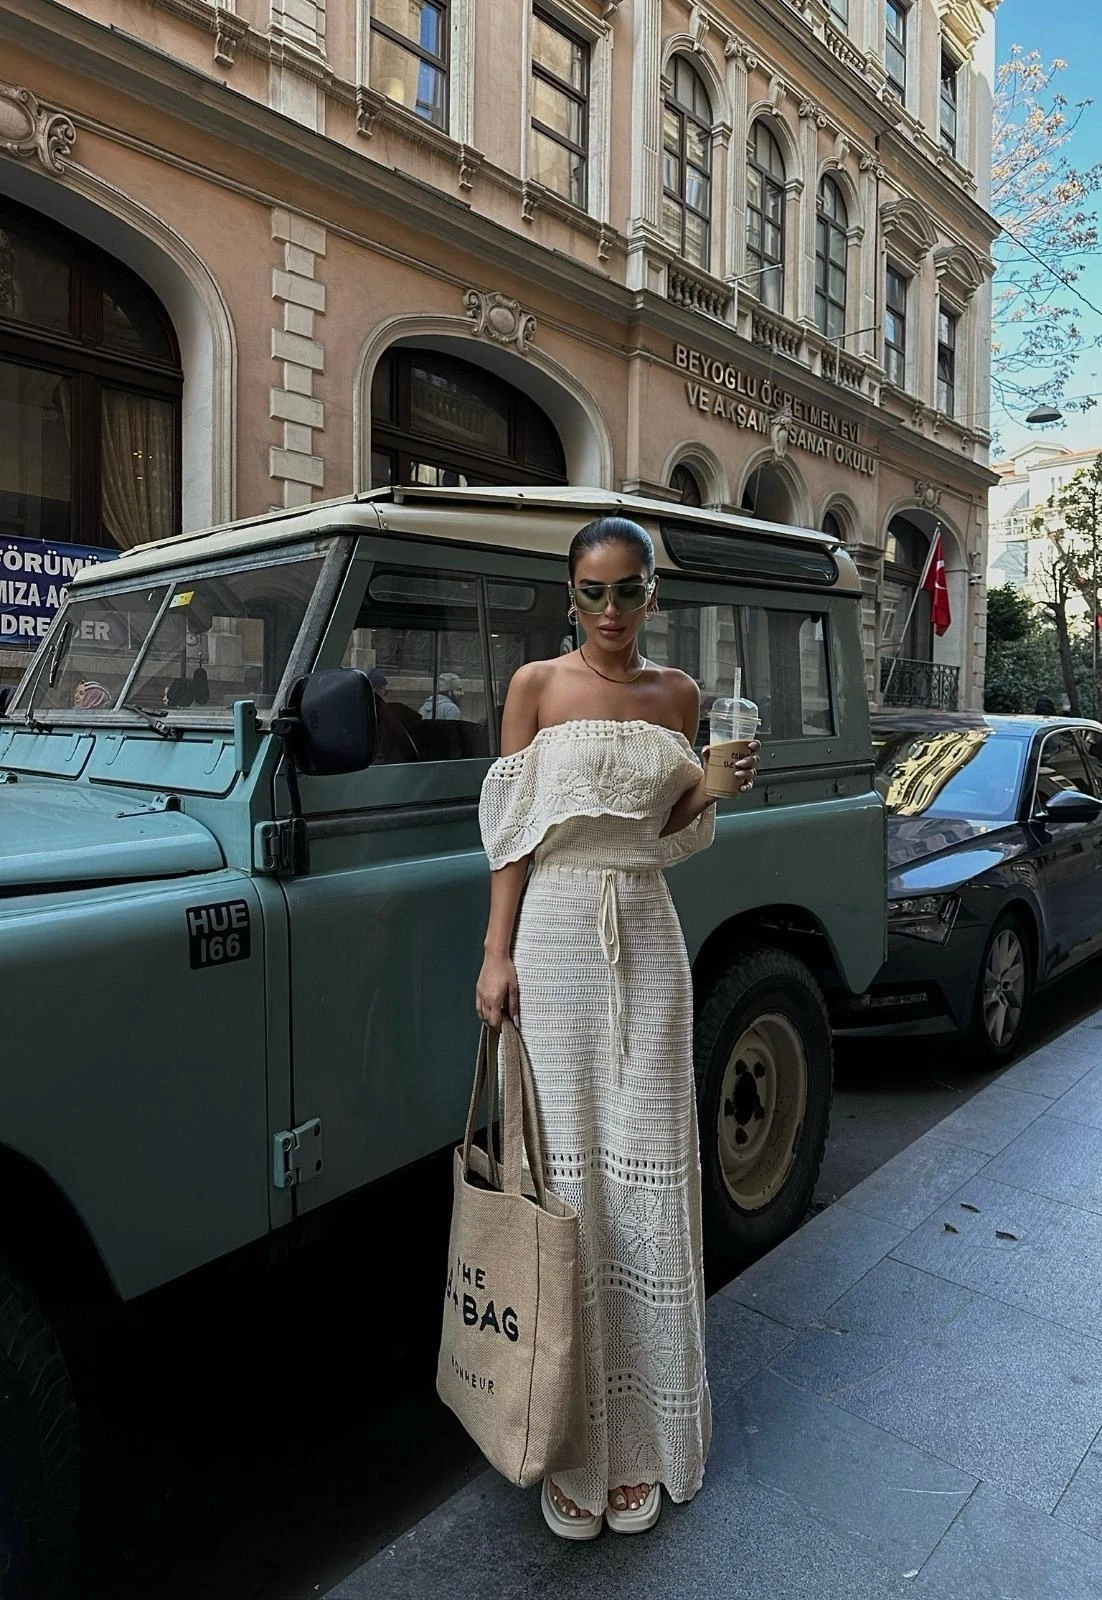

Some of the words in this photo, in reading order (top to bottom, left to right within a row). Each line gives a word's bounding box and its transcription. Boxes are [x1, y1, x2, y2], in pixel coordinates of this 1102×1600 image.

[687, 381, 710, 411] VE
[789, 427, 833, 458] SANAT
[835, 444, 876, 475] OKULU
[189, 904, 248, 936] HUE
[200, 933, 241, 963] 166
